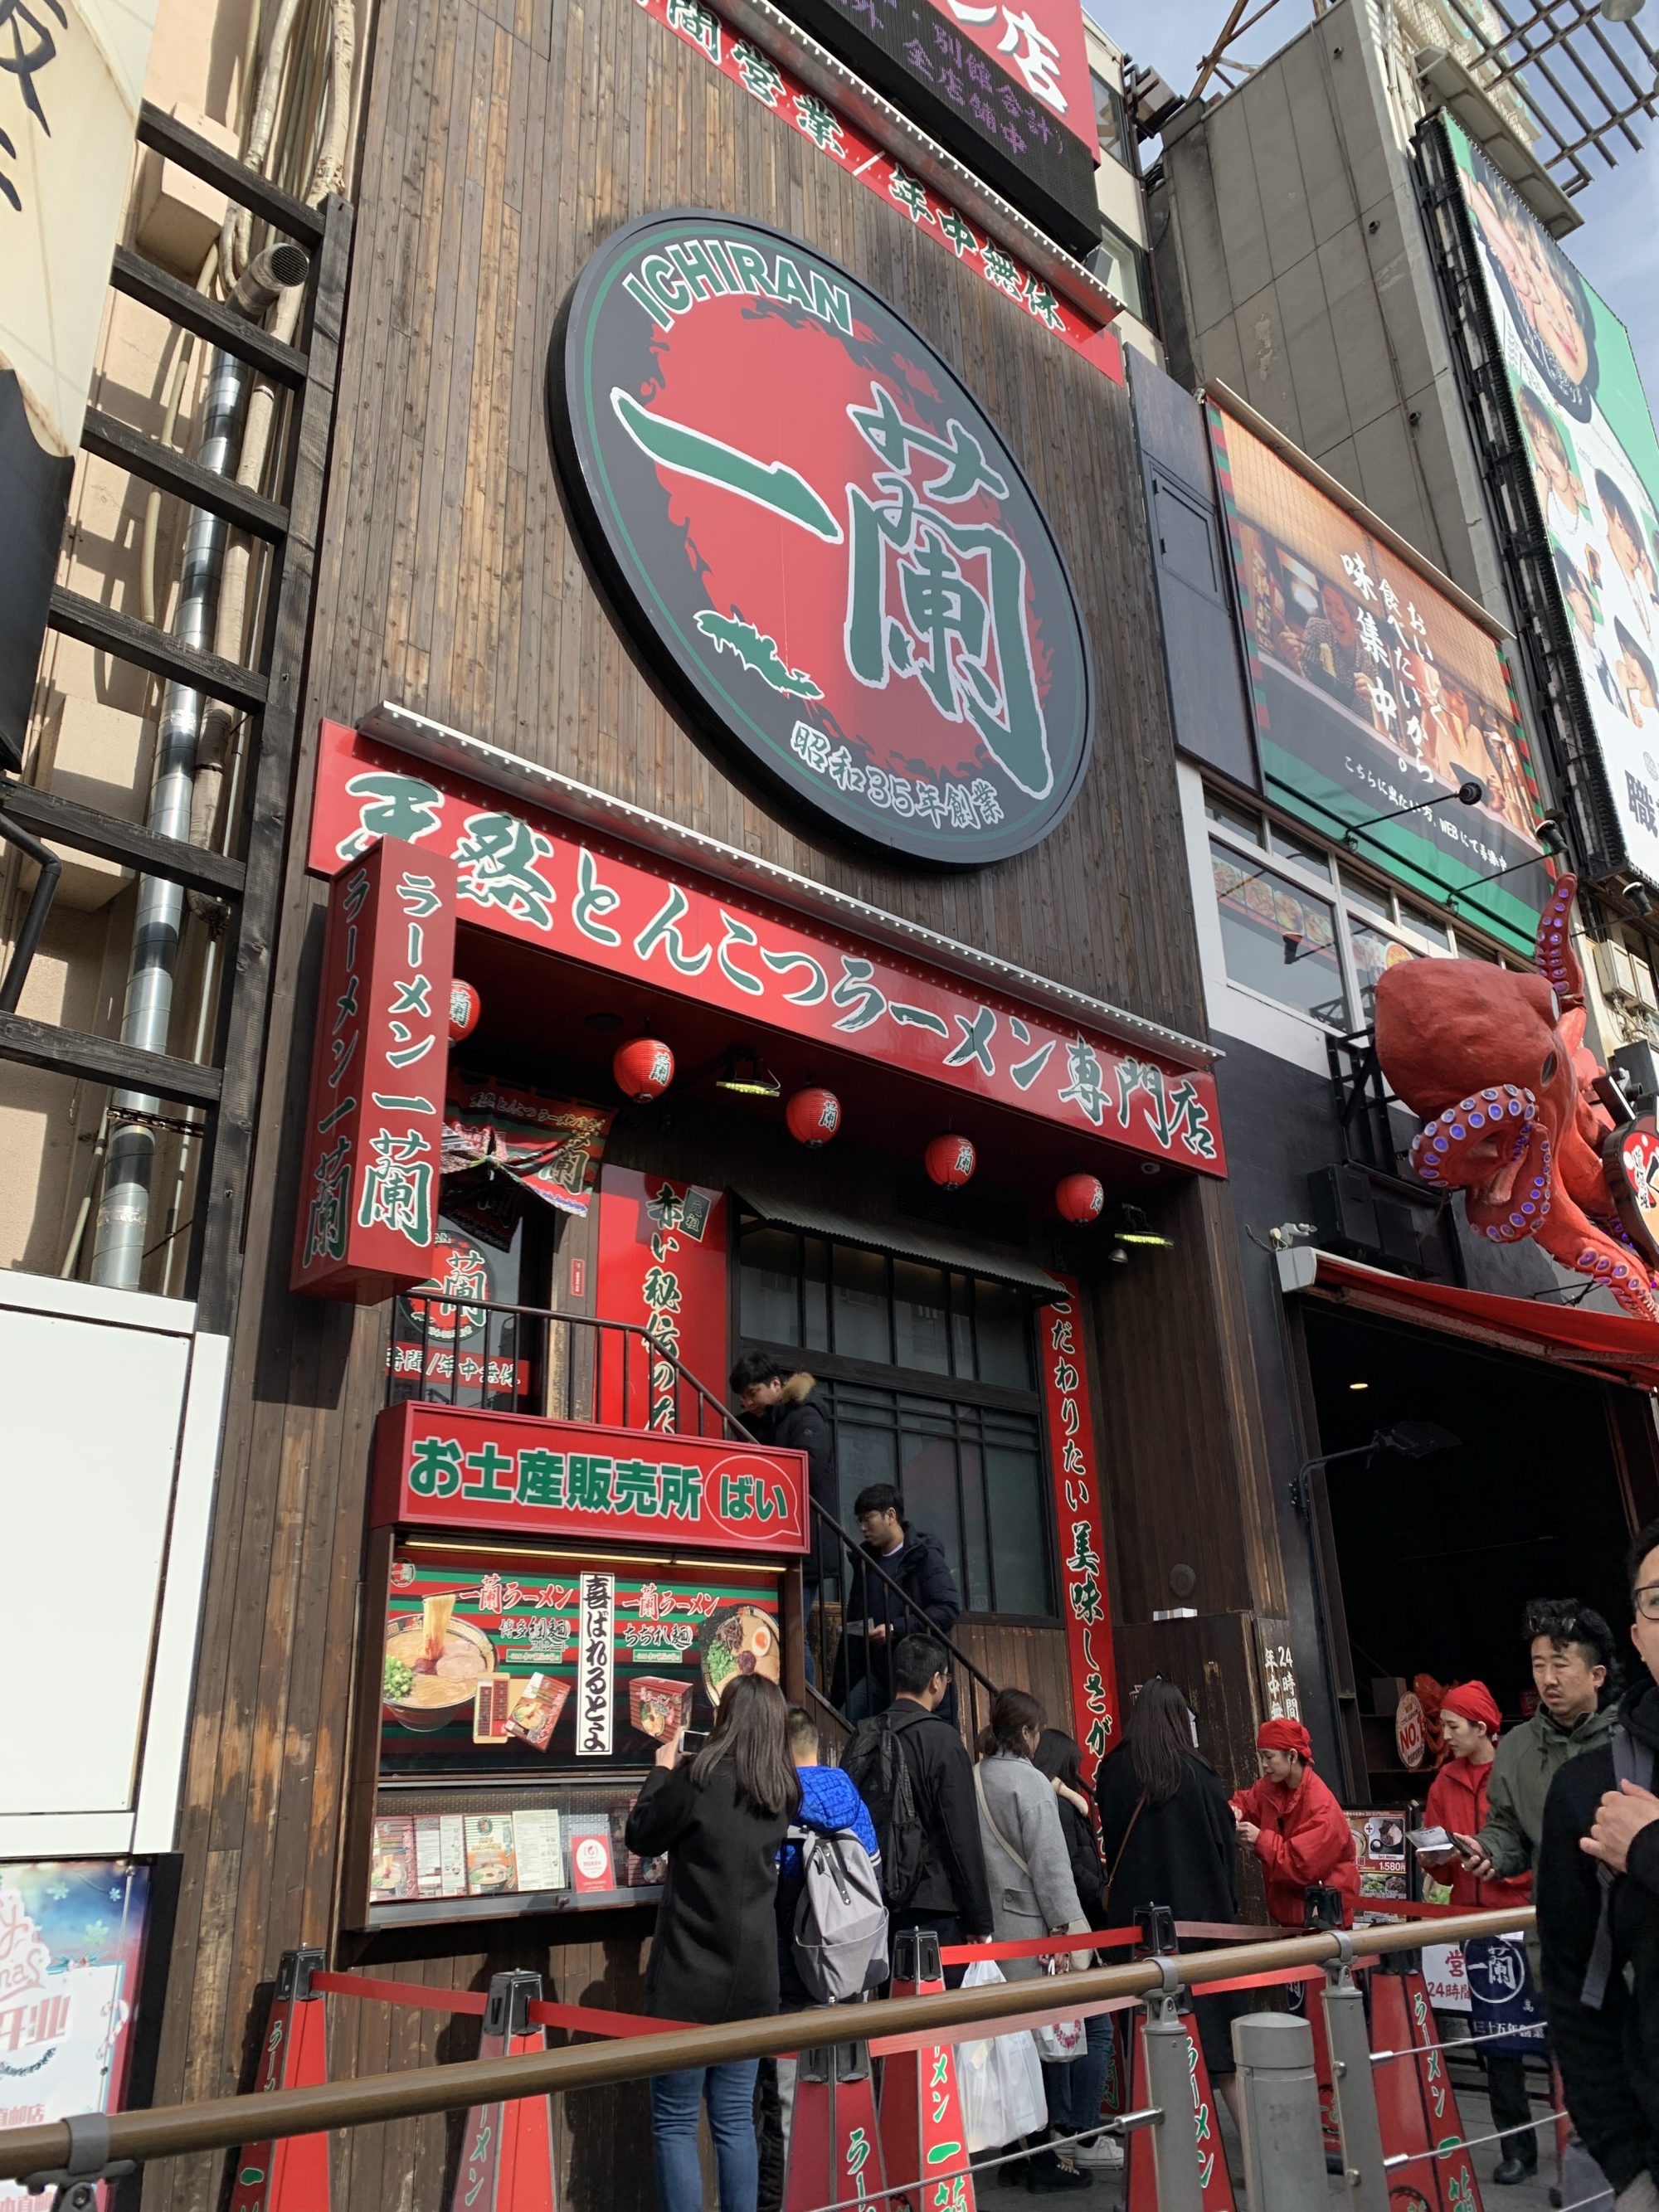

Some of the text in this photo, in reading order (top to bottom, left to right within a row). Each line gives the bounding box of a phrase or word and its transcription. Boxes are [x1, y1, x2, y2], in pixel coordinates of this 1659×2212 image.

[947, 0, 1068, 114] 店
[622, 238, 854, 336] ICHIRAN
[610, 380, 1053, 801] 一蘭
[791, 720, 1005, 829] 昭和35年創業
[336, 771, 1217, 1159] 天然とんこつラーメン専門店
[358, 870, 442, 1248] ラーメン一蘭
[408, 1436, 788, 1523] お土産販売所 ばい
[458, 1573, 575, 1615] 一蘭ラーメン
[622, 1583, 721, 1622] 一蘭ラーメン
